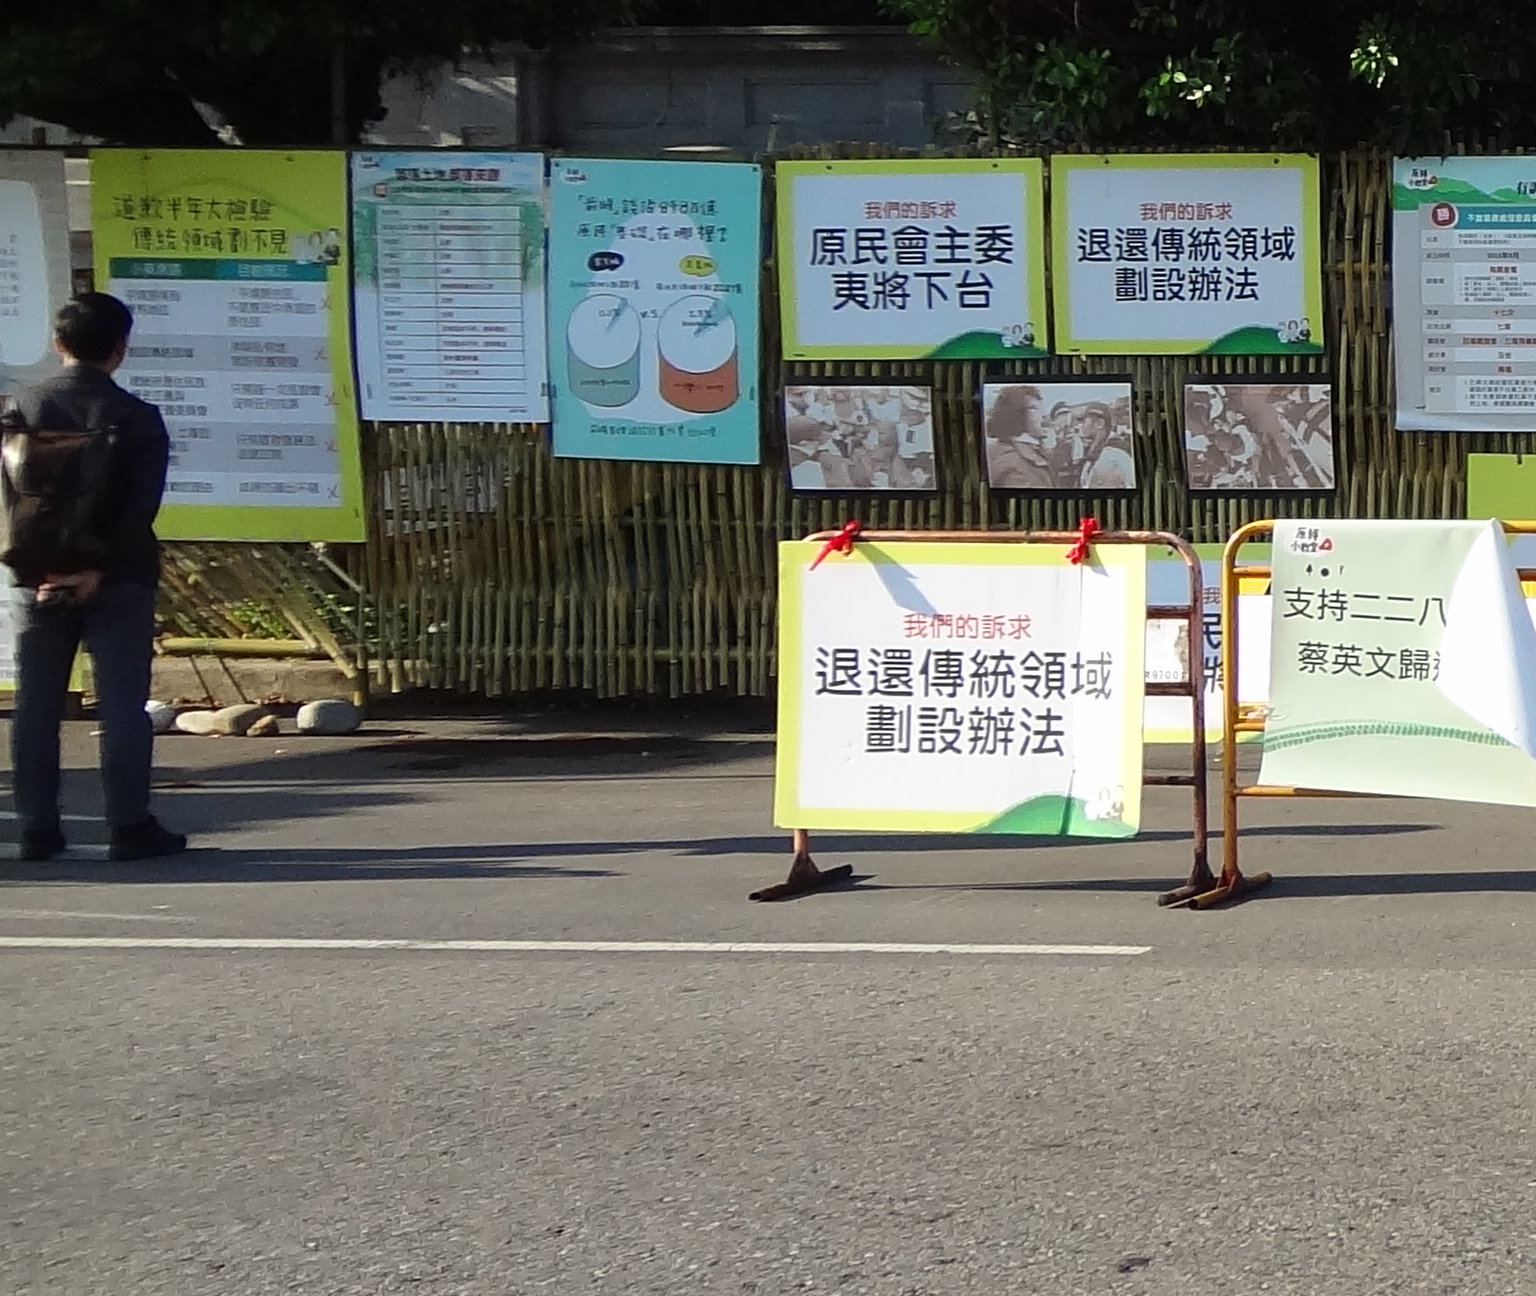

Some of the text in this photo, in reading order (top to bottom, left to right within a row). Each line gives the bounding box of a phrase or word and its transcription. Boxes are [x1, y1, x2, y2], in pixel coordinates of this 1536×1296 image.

[864, 200, 957, 219] 我們的訴求
[1140, 201, 1233, 222] 我們的訴求
[810, 225, 1014, 266] 原民會主委
[1077, 226, 1296, 264] 退還傳統領域
[832, 270, 994, 312] 夷將下台
[1113, 266, 1259, 303] 劃設辦法
[903, 613, 1033, 641] 我們的訴求
[814, 646, 1113, 702] 退還傳統領域
[1298, 640, 1441, 683] 蔡英文歸
[865, 704, 1065, 757] 劃設辦法
